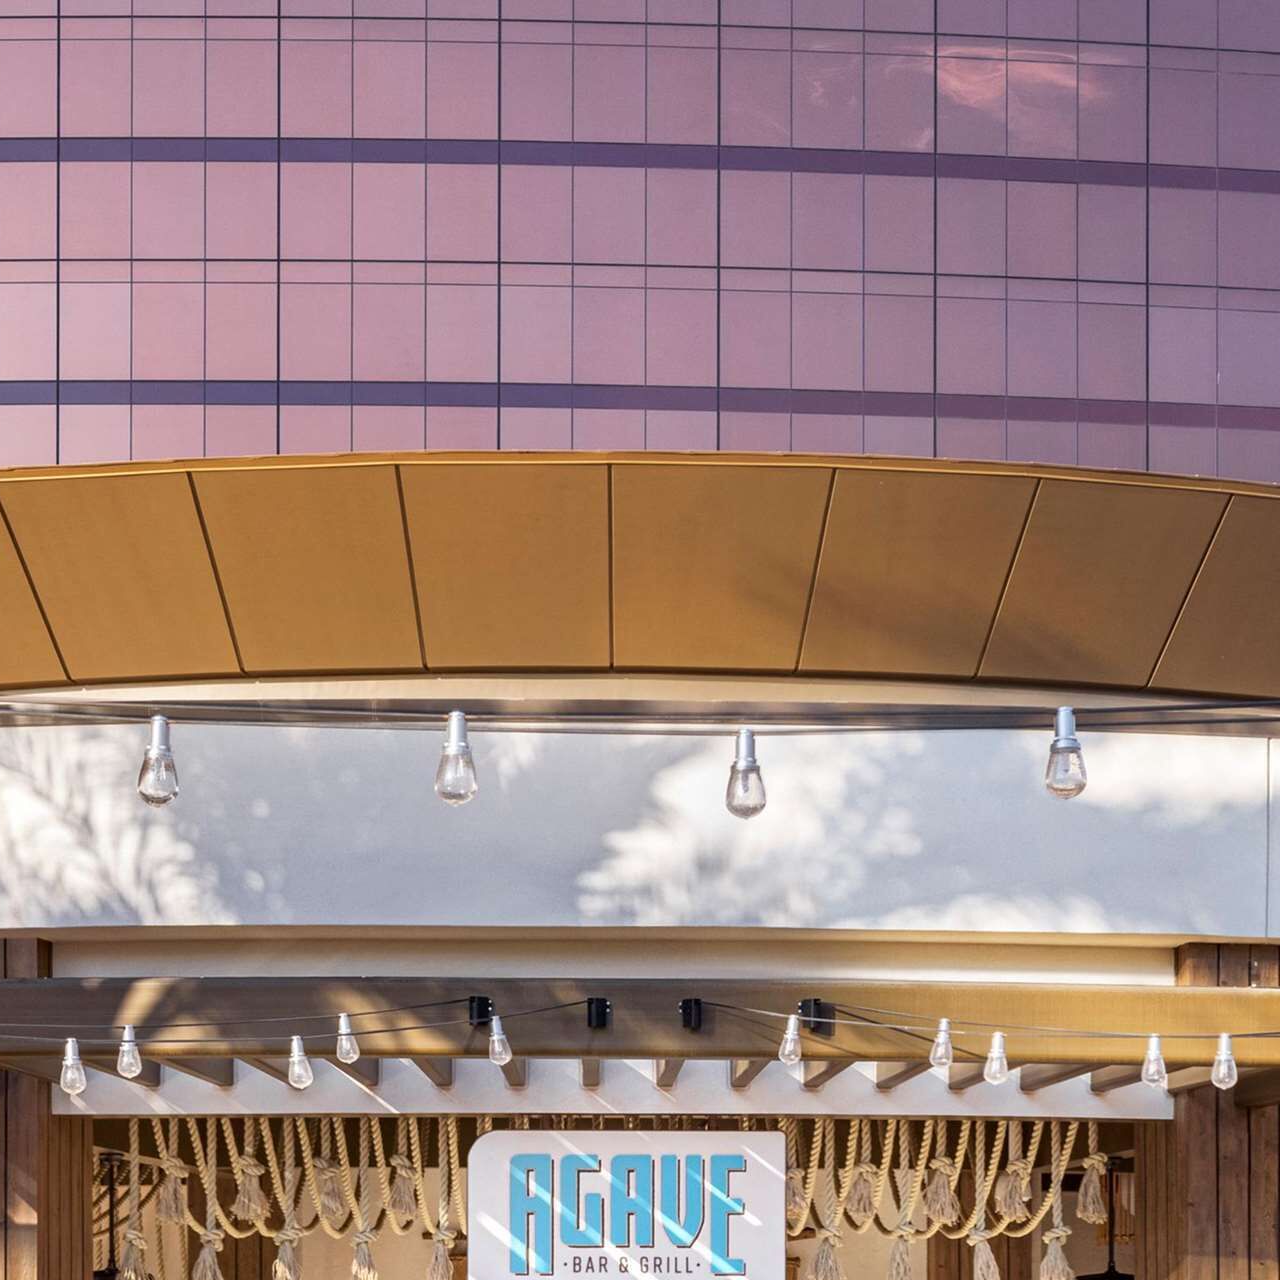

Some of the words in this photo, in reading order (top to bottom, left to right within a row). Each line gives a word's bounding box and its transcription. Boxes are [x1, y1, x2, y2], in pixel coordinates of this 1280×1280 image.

[510, 1154, 746, 1276] AGAVE
[572, 1256, 608, 1274] BAR
[618, 1256, 630, 1274] &
[640, 1256, 694, 1274] GRILL
